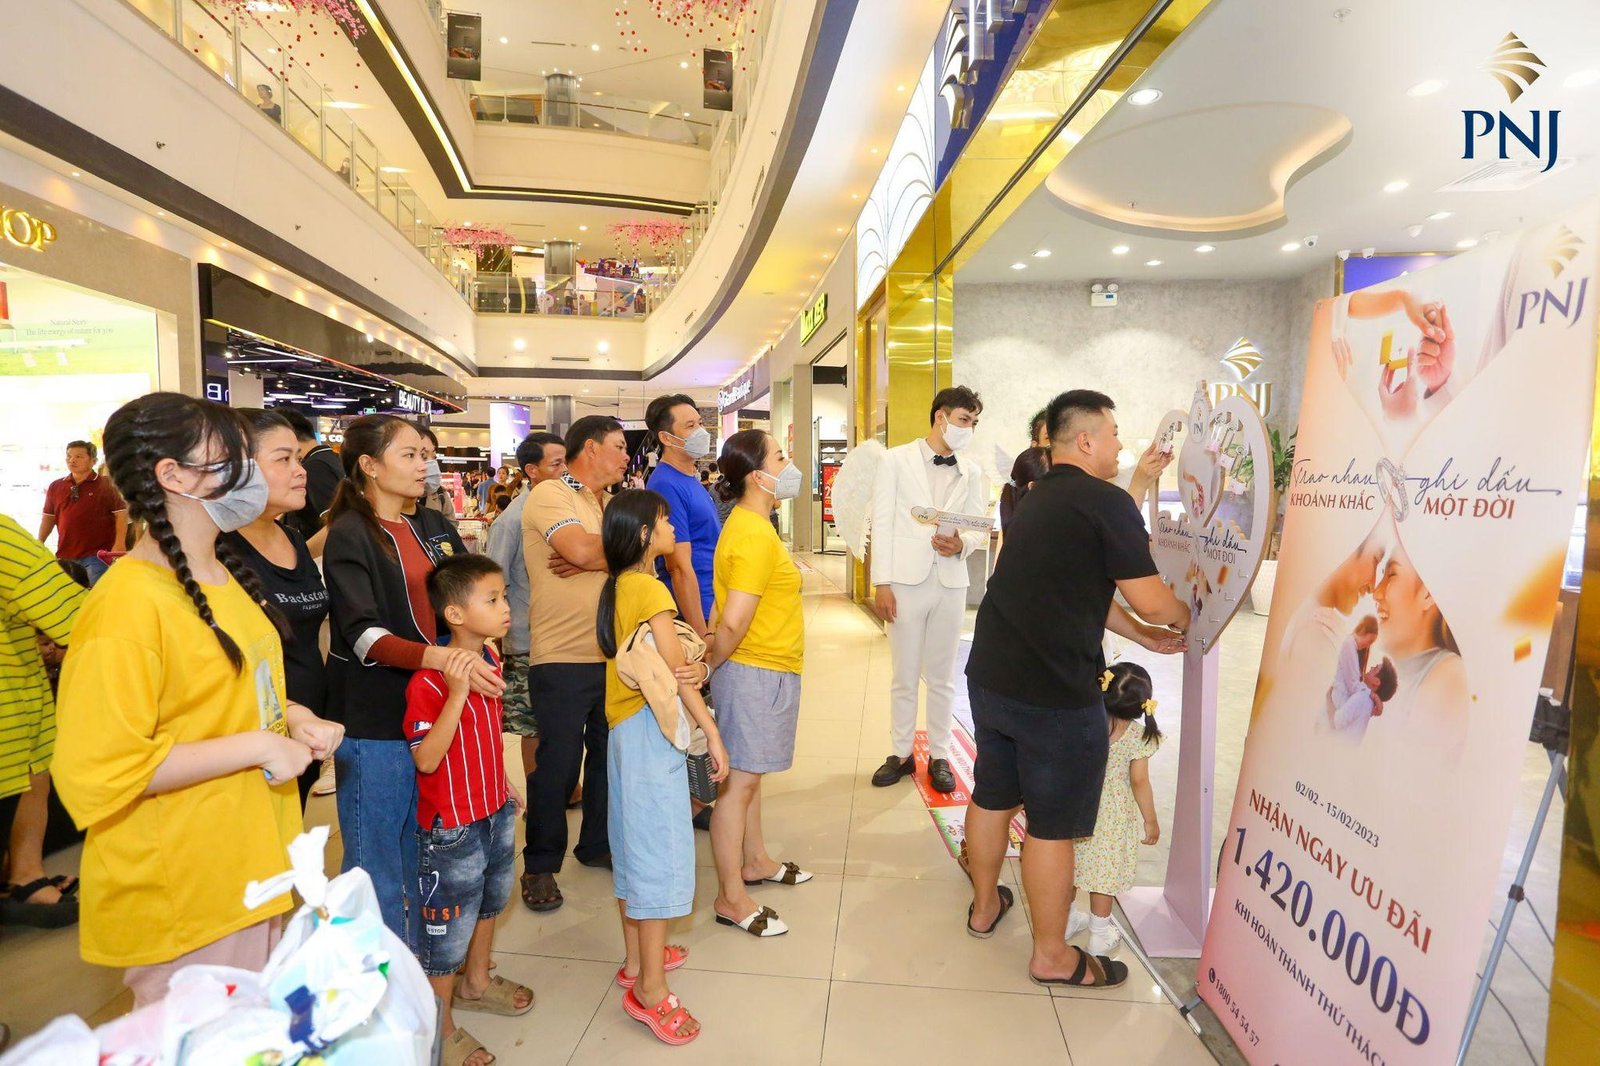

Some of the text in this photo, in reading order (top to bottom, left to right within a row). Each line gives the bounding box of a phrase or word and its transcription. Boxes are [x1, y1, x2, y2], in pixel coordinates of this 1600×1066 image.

[0, 206, 57, 252] OP
[1516, 277, 1589, 329] PNJ
[1290, 489, 1515, 521] KHOÁNH KHẮC MỘT ĐỜI
[1294, 456, 1563, 506] Trao nhau ghi dấu
[274, 590, 329, 604] Backstag
[1295, 780, 1319, 806] 02/02
[1326, 802, 1380, 848] 15/02/2023
[1249, 788, 1432, 955] NHẬN NGAY ƯU ĐÃI
[1234, 827, 1430, 1046] 1.420.000Đ
[1234, 899, 1386, 1066] KHI HOÀN THÀNH THỨ THÁC
[1215, 979, 1260, 1047] 1800 54 54 57
